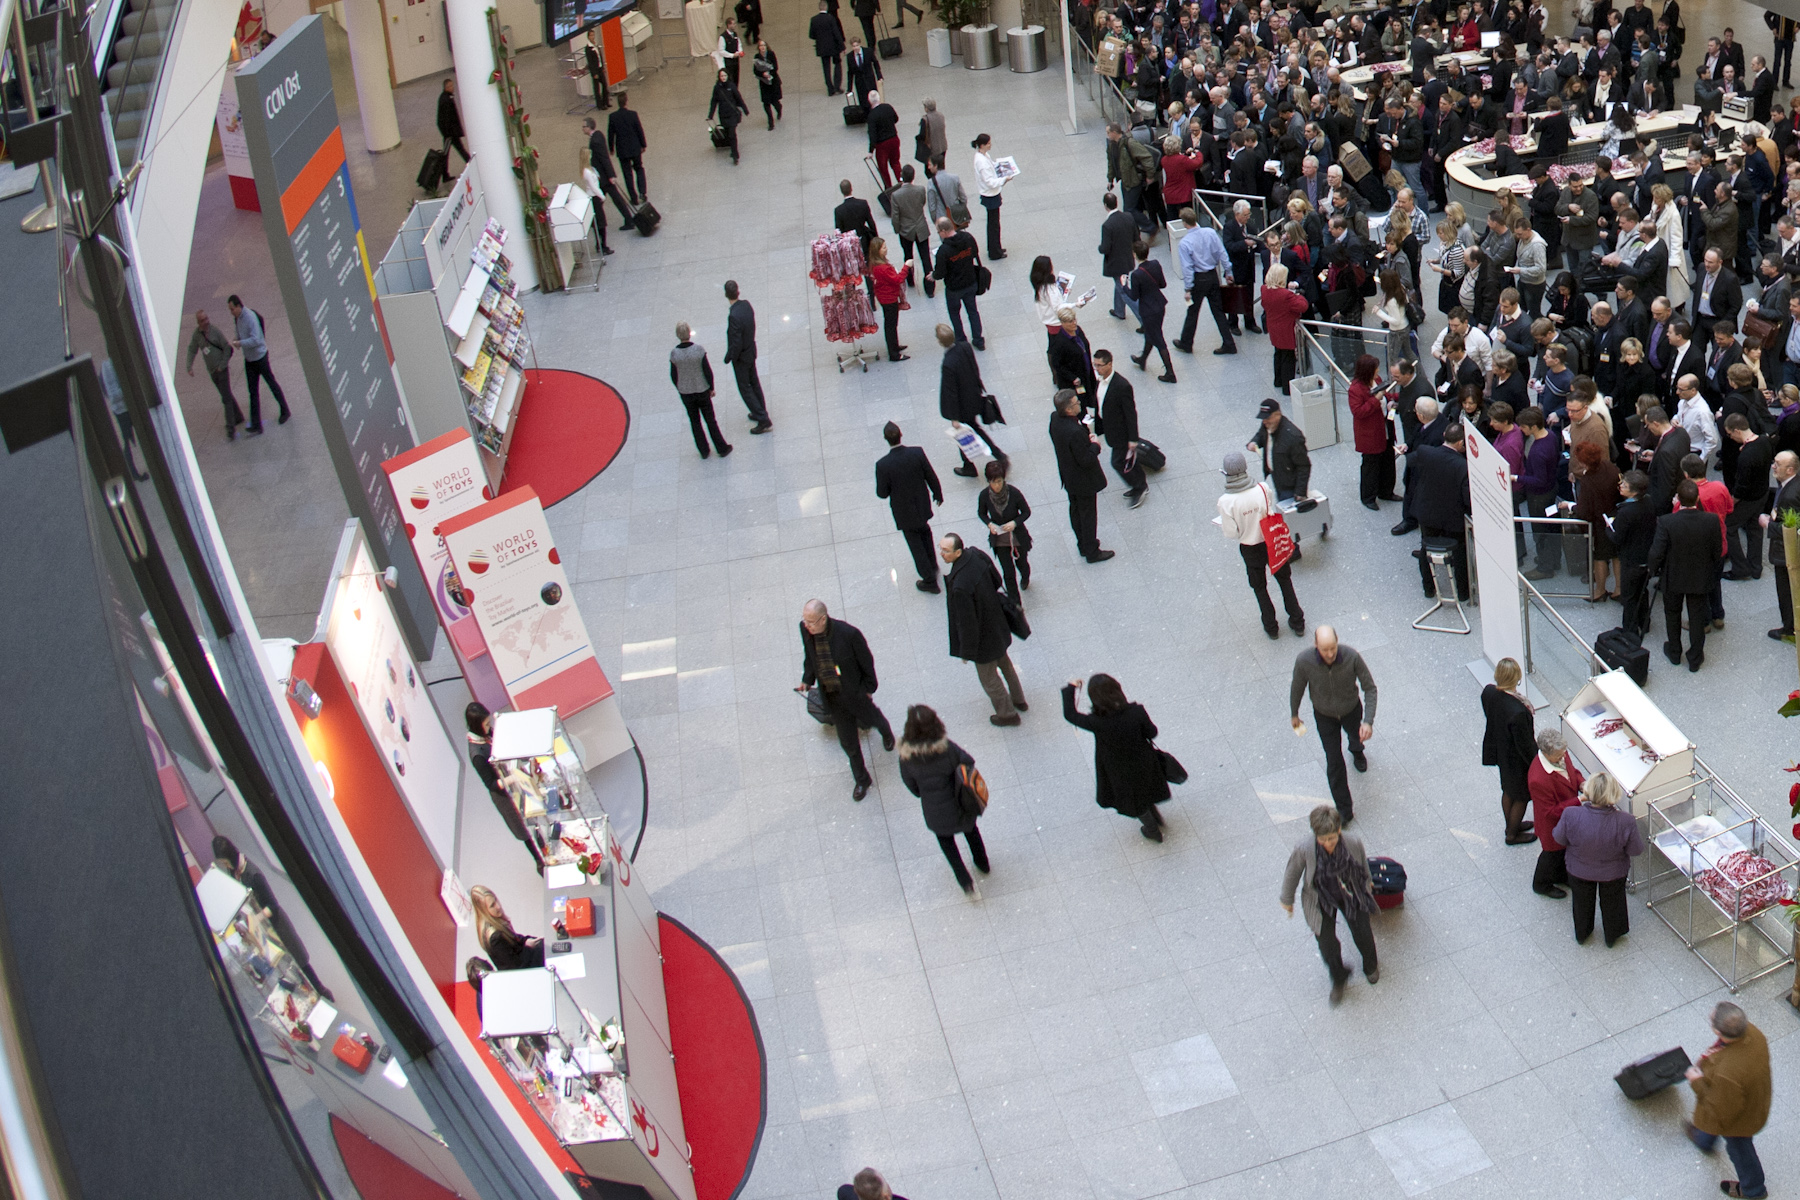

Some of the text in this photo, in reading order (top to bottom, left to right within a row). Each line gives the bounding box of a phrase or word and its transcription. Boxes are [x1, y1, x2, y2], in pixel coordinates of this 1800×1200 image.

[265, 70, 302, 120] CCN Ost
[337, 175, 345, 197] 3
[439, 193, 466, 251] MEDIA POINT
[353, 246, 361, 267] 2
[371, 313, 378, 332] 1
[397, 406, 406, 426] 0
[432, 466, 471, 491] WORLD
[436, 487, 448, 500] OF
[448, 476, 473, 493] TOYS
[492, 529, 535, 553] WORLD
[497, 552, 509, 563] OF
[511, 540, 538, 557] TOYS
